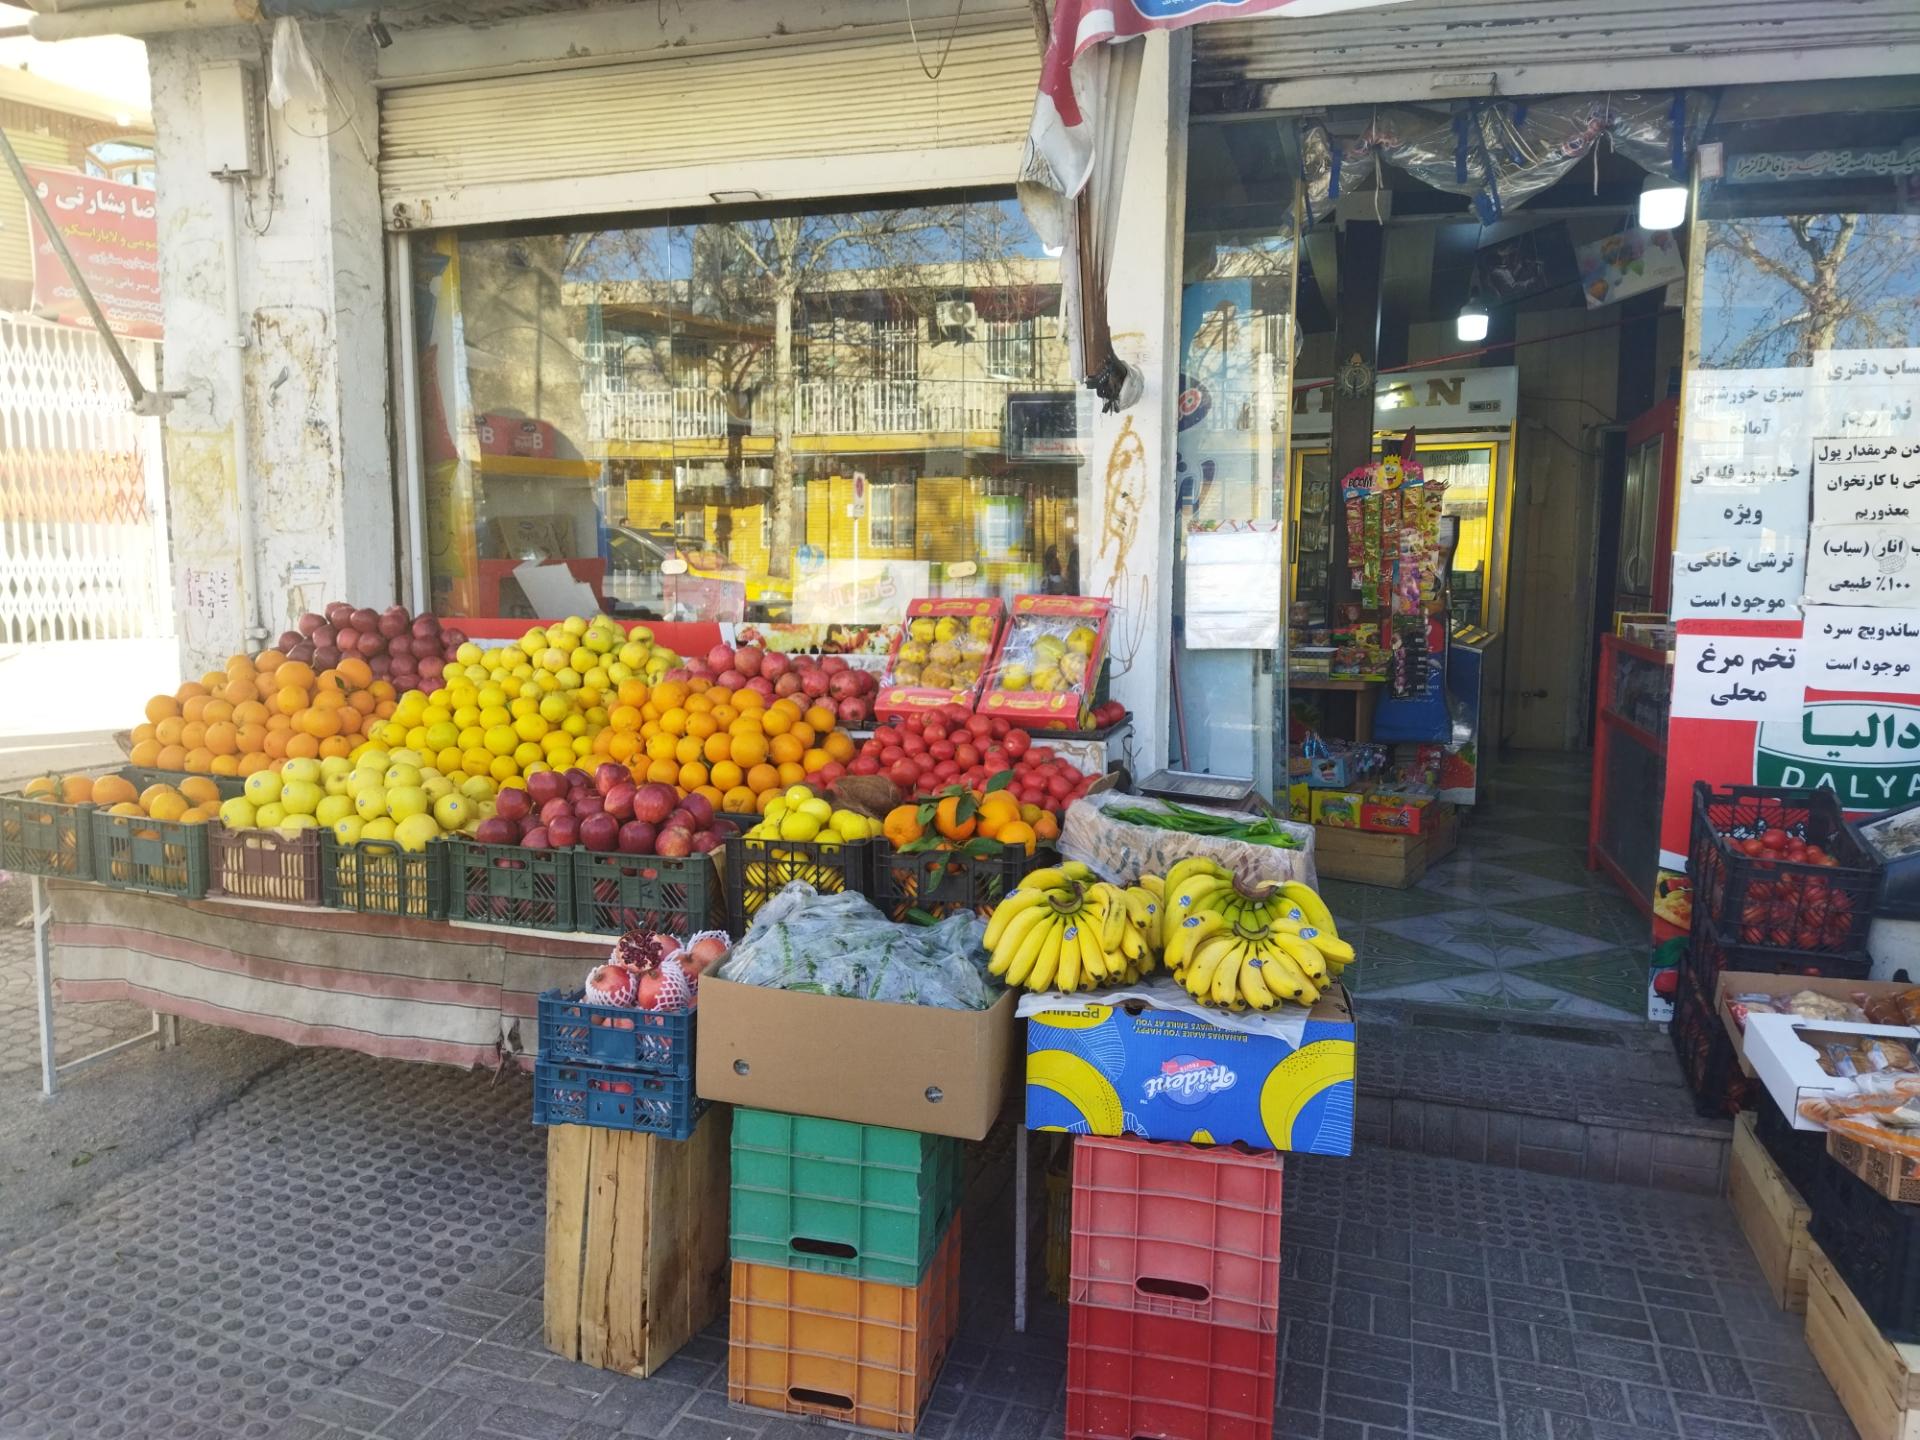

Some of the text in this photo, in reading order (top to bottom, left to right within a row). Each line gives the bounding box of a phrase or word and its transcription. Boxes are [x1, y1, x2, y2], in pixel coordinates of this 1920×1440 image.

[132, 196, 156, 219] ضا
[1828, 359, 1920, 381] ساب دفتری
[1763, 386, 1804, 403] سبزی
[1730, 418, 1771, 435] آماده
[1818, 446, 1842, 461] پول
[1901, 444, 1920, 459] دن
[1890, 473, 1899, 489] با
[1723, 503, 1763, 525] ویژه
[1855, 503, 1909, 520] معذوریم
[1876, 539, 1904, 557] انار
[1687, 551, 1795, 573] ترشی خانگی
[1828, 576, 1872, 592] طبیعی
[1690, 591, 1786, 614] موجود است
[1823, 622, 1919, 641] ساندویچ سرد
[1696, 642, 1797, 675] تخم مرغ
[1825, 656, 1911, 677] موجود است
[1710, 682, 1767, 706] محلی
[1802, 710, 1920, 758] دالیا
[1135, 1017, 1152, 1027] YOU
[1153, 1019, 1165, 1028] AT
[1165, 1020, 1190, 1030] SMILE
[1163, 1028, 1181, 1037] YOU
[1182, 1030, 1206, 1038] MAKE
[1207, 1031, 1248, 1043] BANANAS
[1145, 1064, 1235, 1099] Trident
